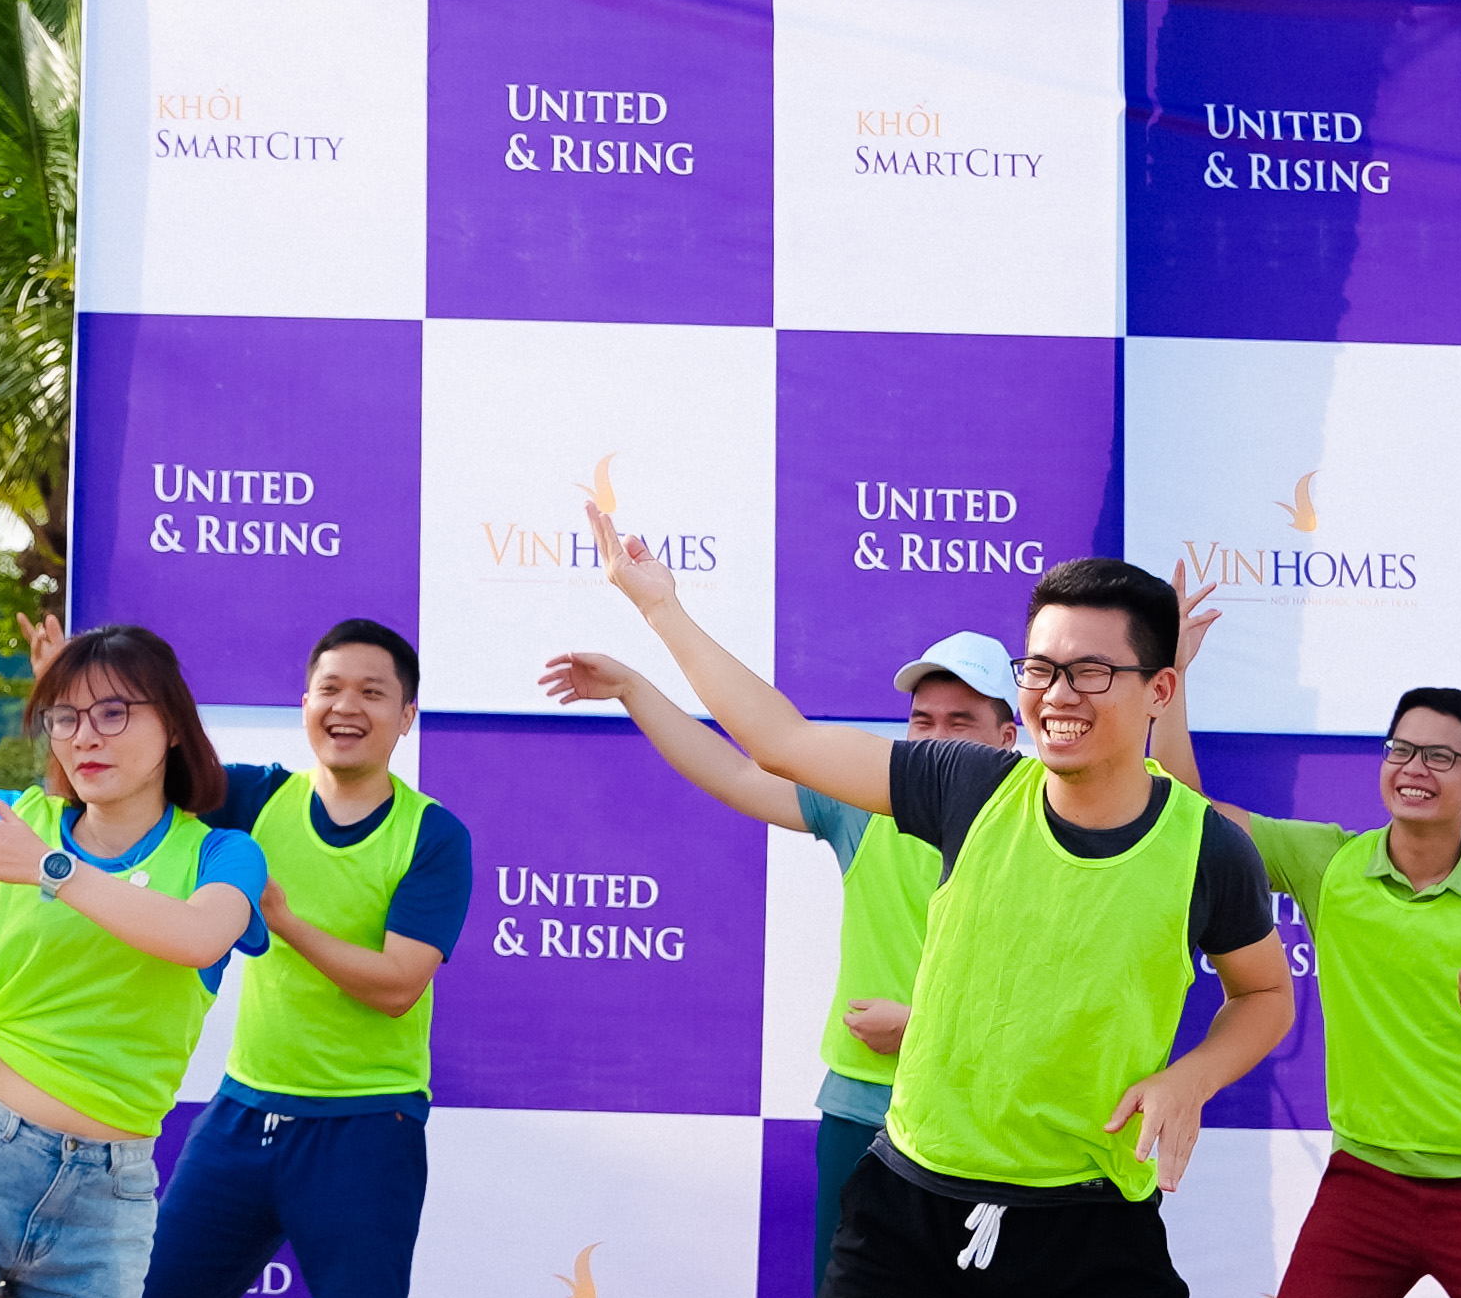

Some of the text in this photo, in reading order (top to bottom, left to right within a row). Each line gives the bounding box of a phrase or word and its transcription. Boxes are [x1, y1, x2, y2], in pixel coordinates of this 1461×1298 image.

[506, 85, 669, 125] UNITED
[1206, 105, 1363, 143] UNITED
[505, 134, 695, 176] & RISING
[1205, 153, 1392, 194] & RISING
[154, 465, 315, 506] UNITED
[856, 482, 1018, 524] UNITED
[150, 515, 341, 558] & RISING
[481, 521, 718, 572] VINHMES
[854, 532, 1045, 576] & RISING
[1182, 541, 1418, 590] VINHOMES
[499, 868, 659, 909] UNITED
[494, 918, 685, 962] & RISING
